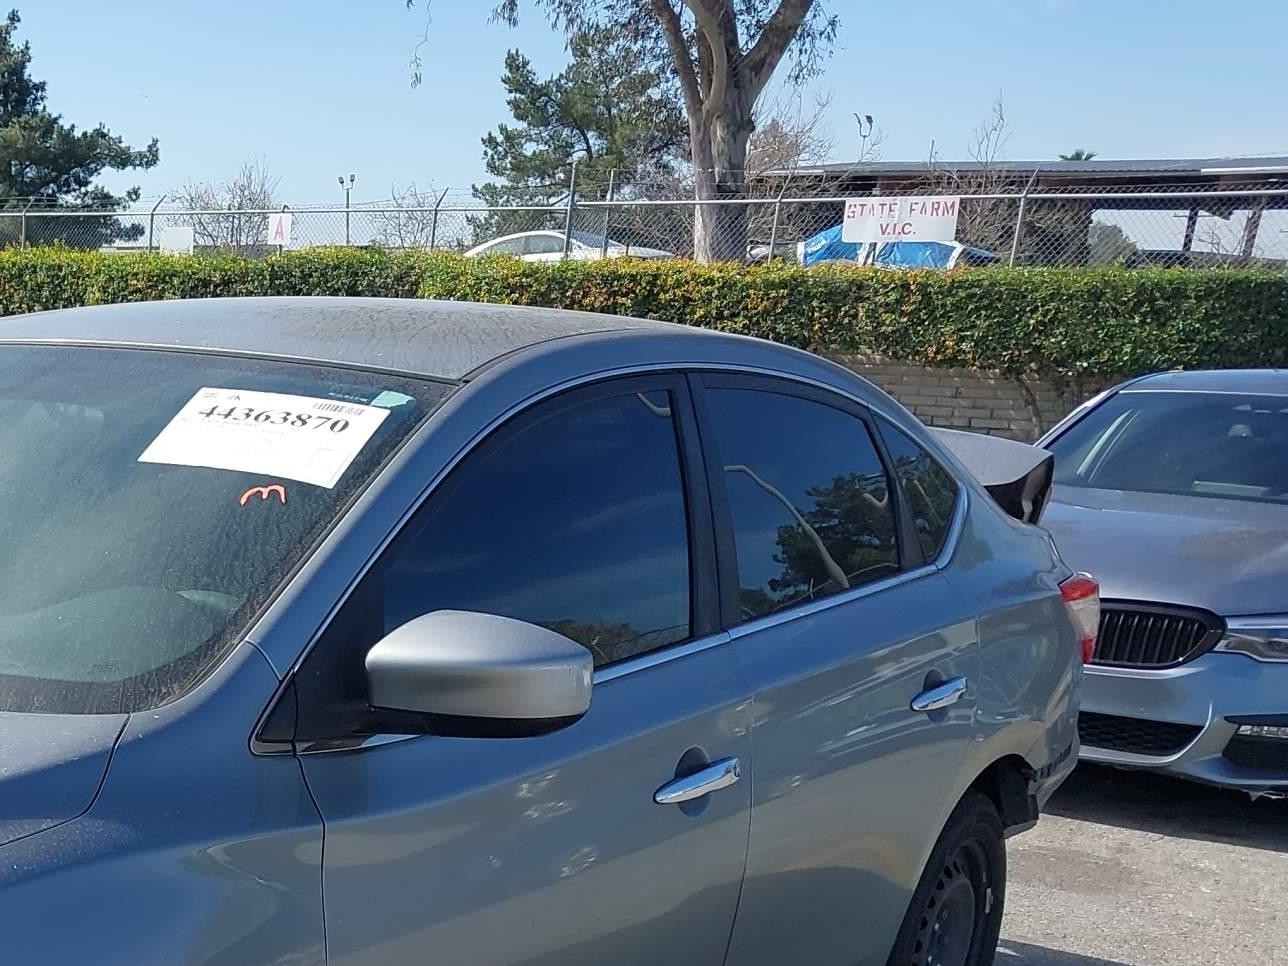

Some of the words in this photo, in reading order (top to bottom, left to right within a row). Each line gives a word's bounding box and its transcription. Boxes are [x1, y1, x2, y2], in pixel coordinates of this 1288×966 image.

[847, 203, 899, 219] STATE
[909, 201, 956, 217] FARM
[274, 215, 284, 241] A
[879, 222, 917, 236] V.I.C.
[198, 404, 350, 433] 44363870
